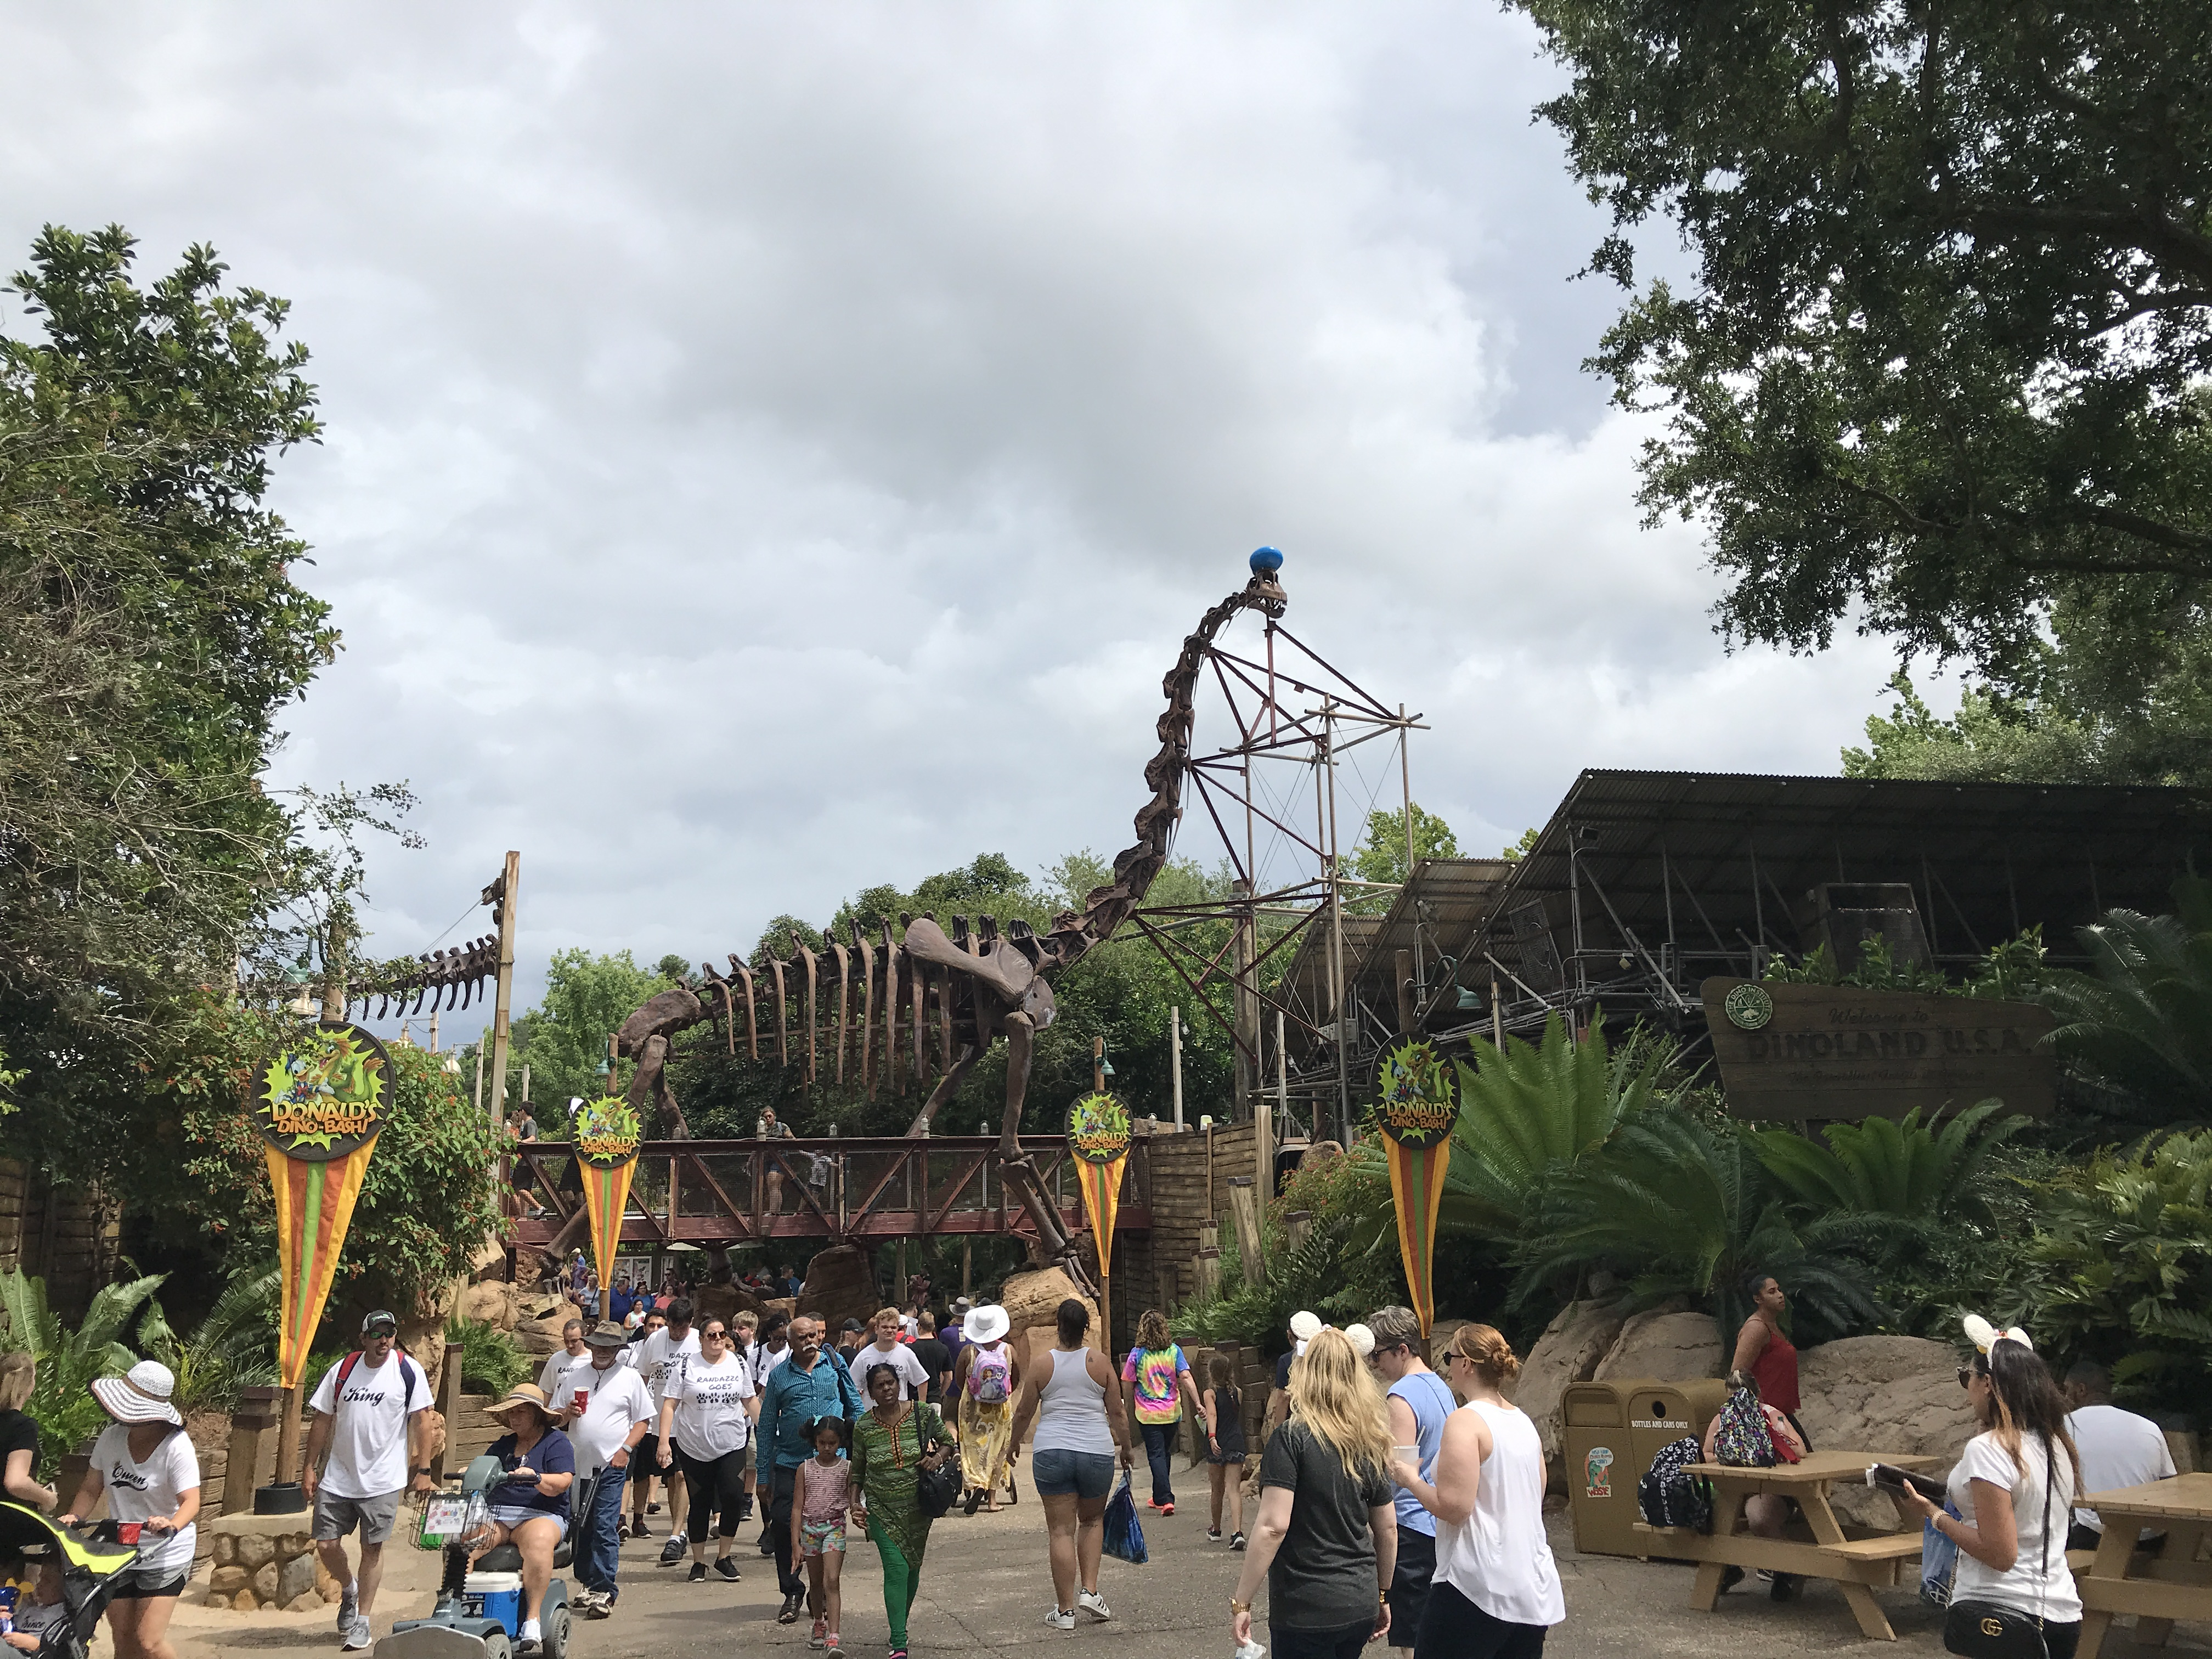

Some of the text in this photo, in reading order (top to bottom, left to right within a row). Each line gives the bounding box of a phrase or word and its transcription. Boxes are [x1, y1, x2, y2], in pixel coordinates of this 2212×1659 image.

[1731, 988, 1746, 1000] DINO
[1829, 1006, 1929, 1024] Welcome to
[1747, 1028, 2032, 1060] DINOLAND U.S.A.
[272, 1099, 377, 1122] DONALD'S
[1386, 1099, 1452, 1120] DONALD'S
[276, 1118, 369, 1134] DINO-BASH!
[1391, 1115, 1447, 1130] DINO-BASH!
[580, 1135, 637, 1148] DONALD'S
[1076, 1130, 1128, 1143] DONALD'S
[583, 1144, 633, 1154] DINO-BASH!
[1080, 1141, 1125, 1149] DINO-BASH!
[343, 1387, 387, 1407] King
[1631, 1420, 1651, 1428] BOTTLES
[1675, 1421, 1688, 1429] ONLY
[112, 1465, 146, 1486] Queen
